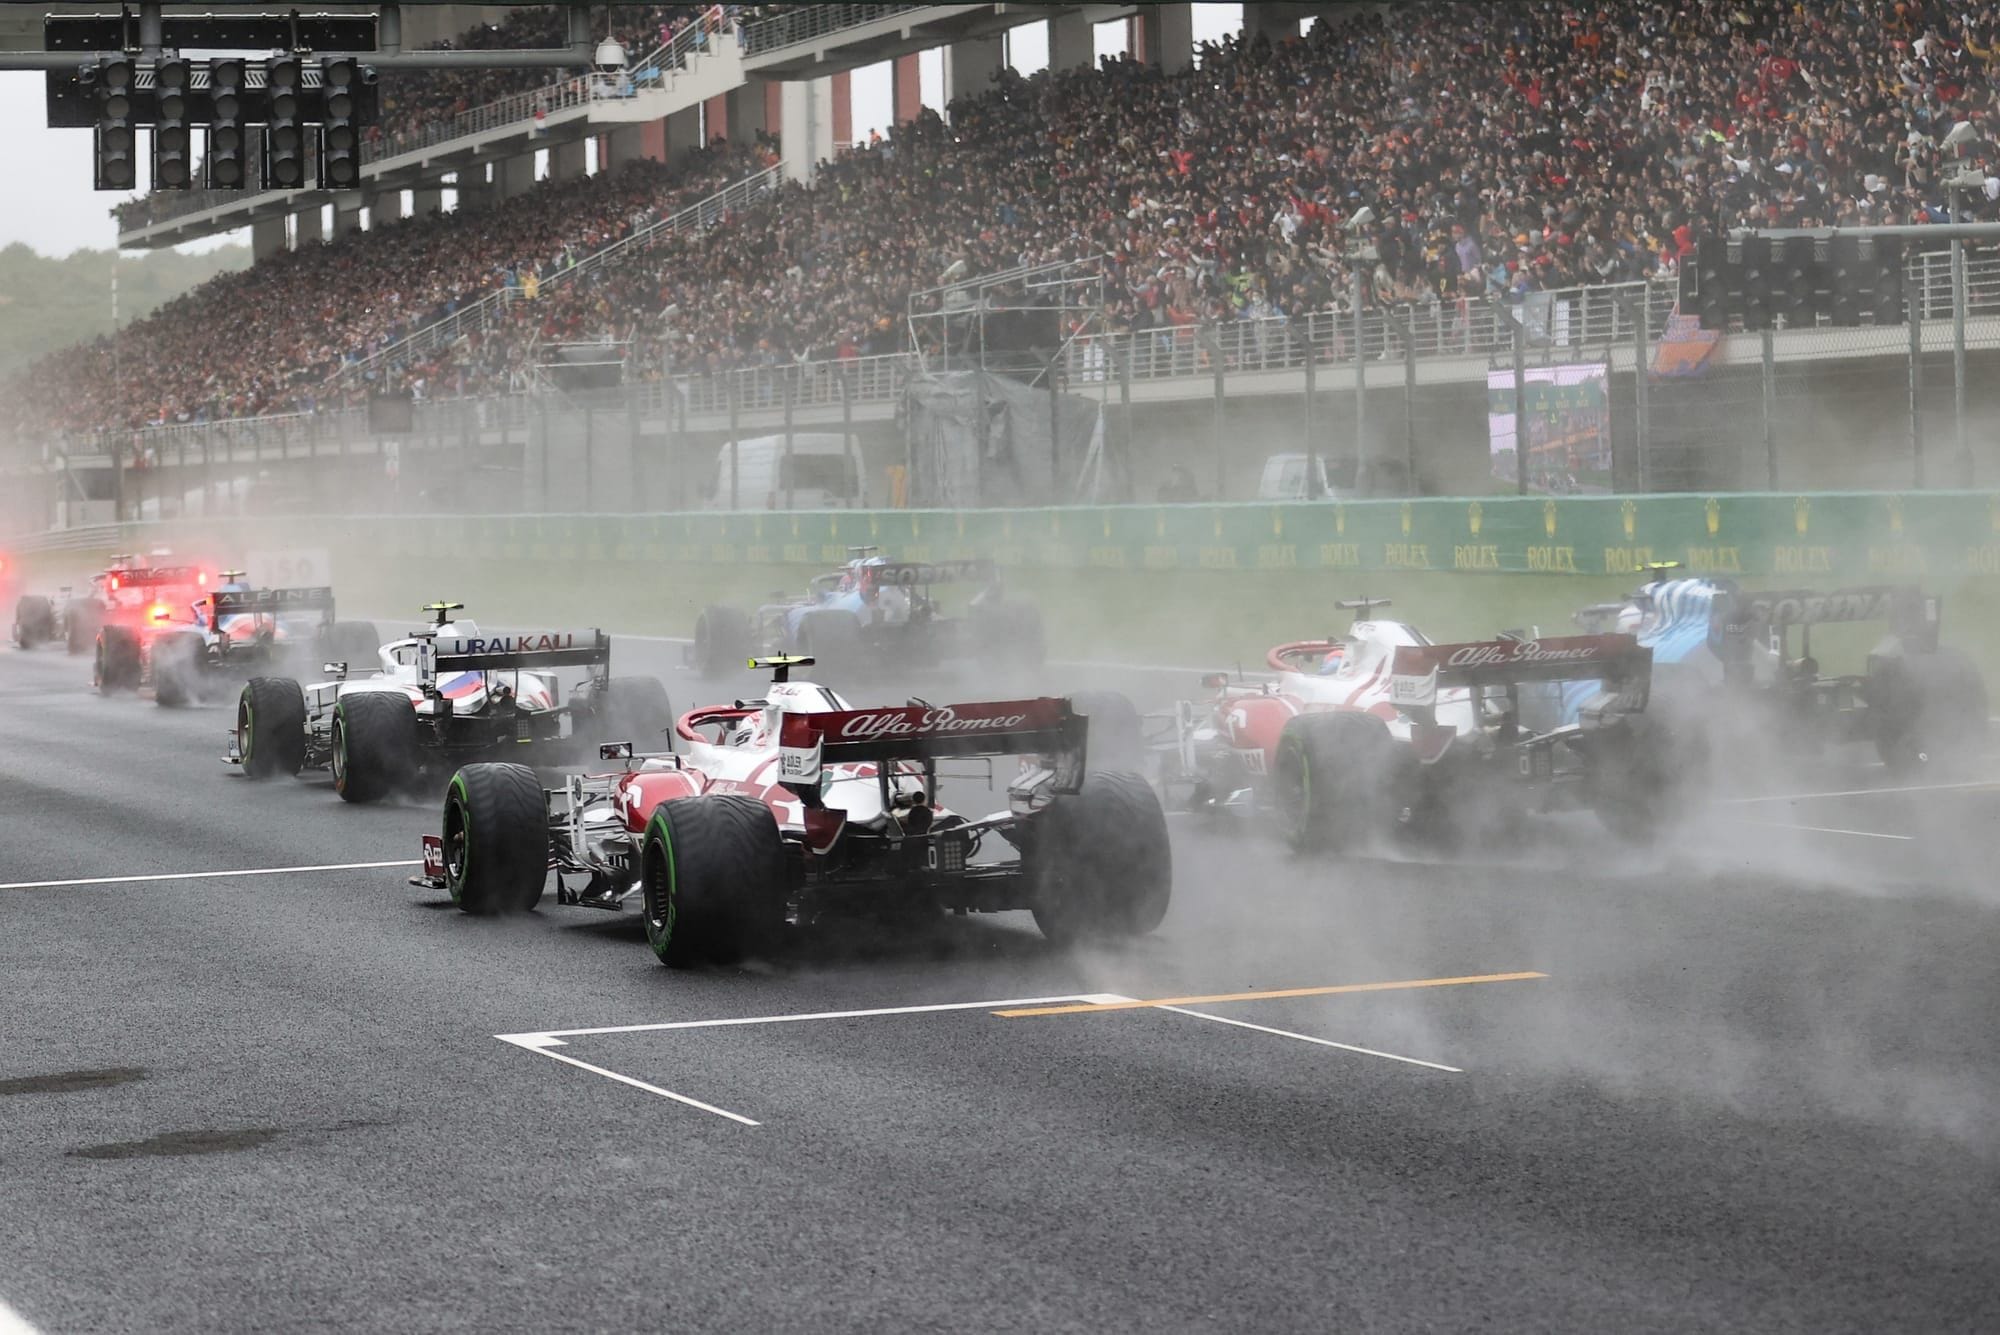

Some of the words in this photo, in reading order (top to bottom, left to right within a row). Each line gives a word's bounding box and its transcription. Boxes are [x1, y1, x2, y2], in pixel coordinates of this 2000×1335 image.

[1385, 543, 1430, 567] ROLEX
[1454, 544, 1500, 568] ROLEX
[1527, 546, 1577, 570] ROLEX
[1687, 547, 1744, 573] ROLEX
[1774, 546, 1832, 573] ROLEX
[220, 588, 322, 604] ALPINE
[455, 633, 573, 655] URALKALI
[1448, 648, 1510, 668] Alfa
[1510, 642, 1599, 664] Romeo
[841, 713, 918, 739] Alfa
[917, 707, 1027, 734] Romeo
